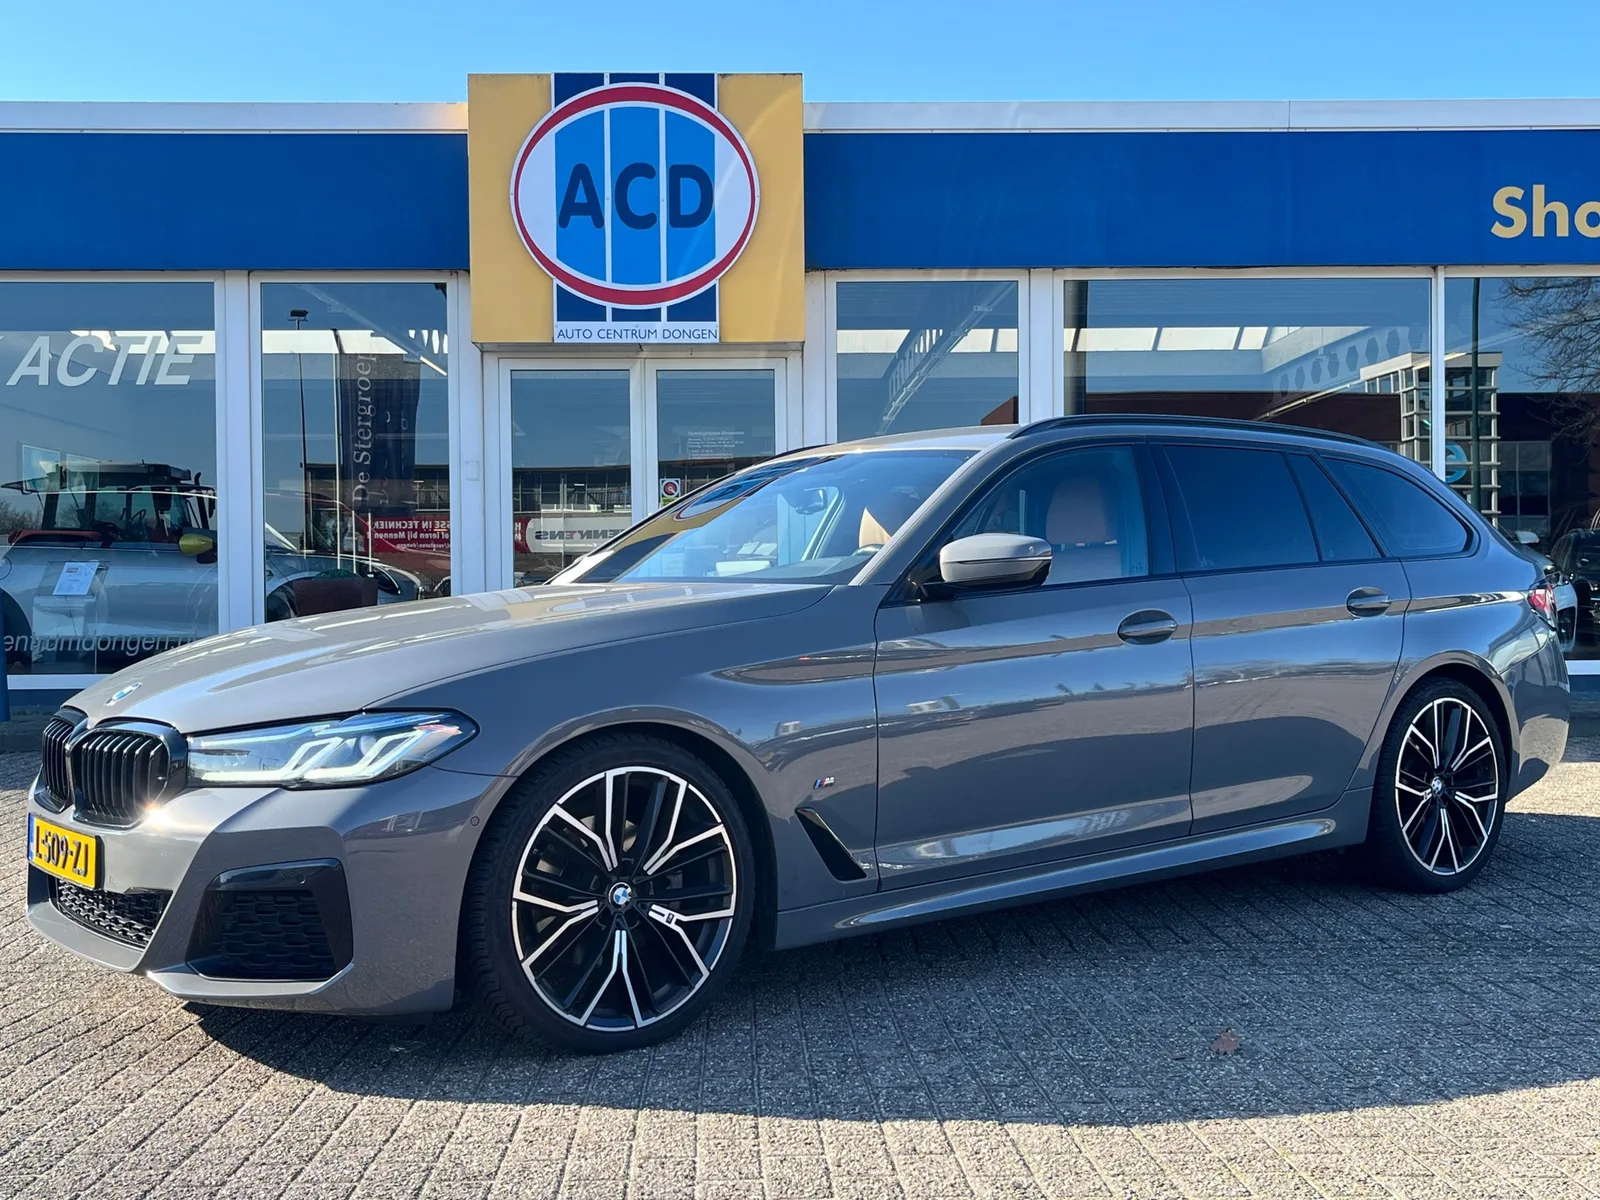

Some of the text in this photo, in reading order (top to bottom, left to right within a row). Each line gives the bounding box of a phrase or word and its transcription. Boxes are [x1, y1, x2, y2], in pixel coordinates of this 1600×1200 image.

[557, 162, 714, 230] ACD
[1490, 184, 1600, 239] Sho
[6, 334, 204, 387] ACTIE
[557, 328, 718, 340] AUTO CENTRUM DONGEN
